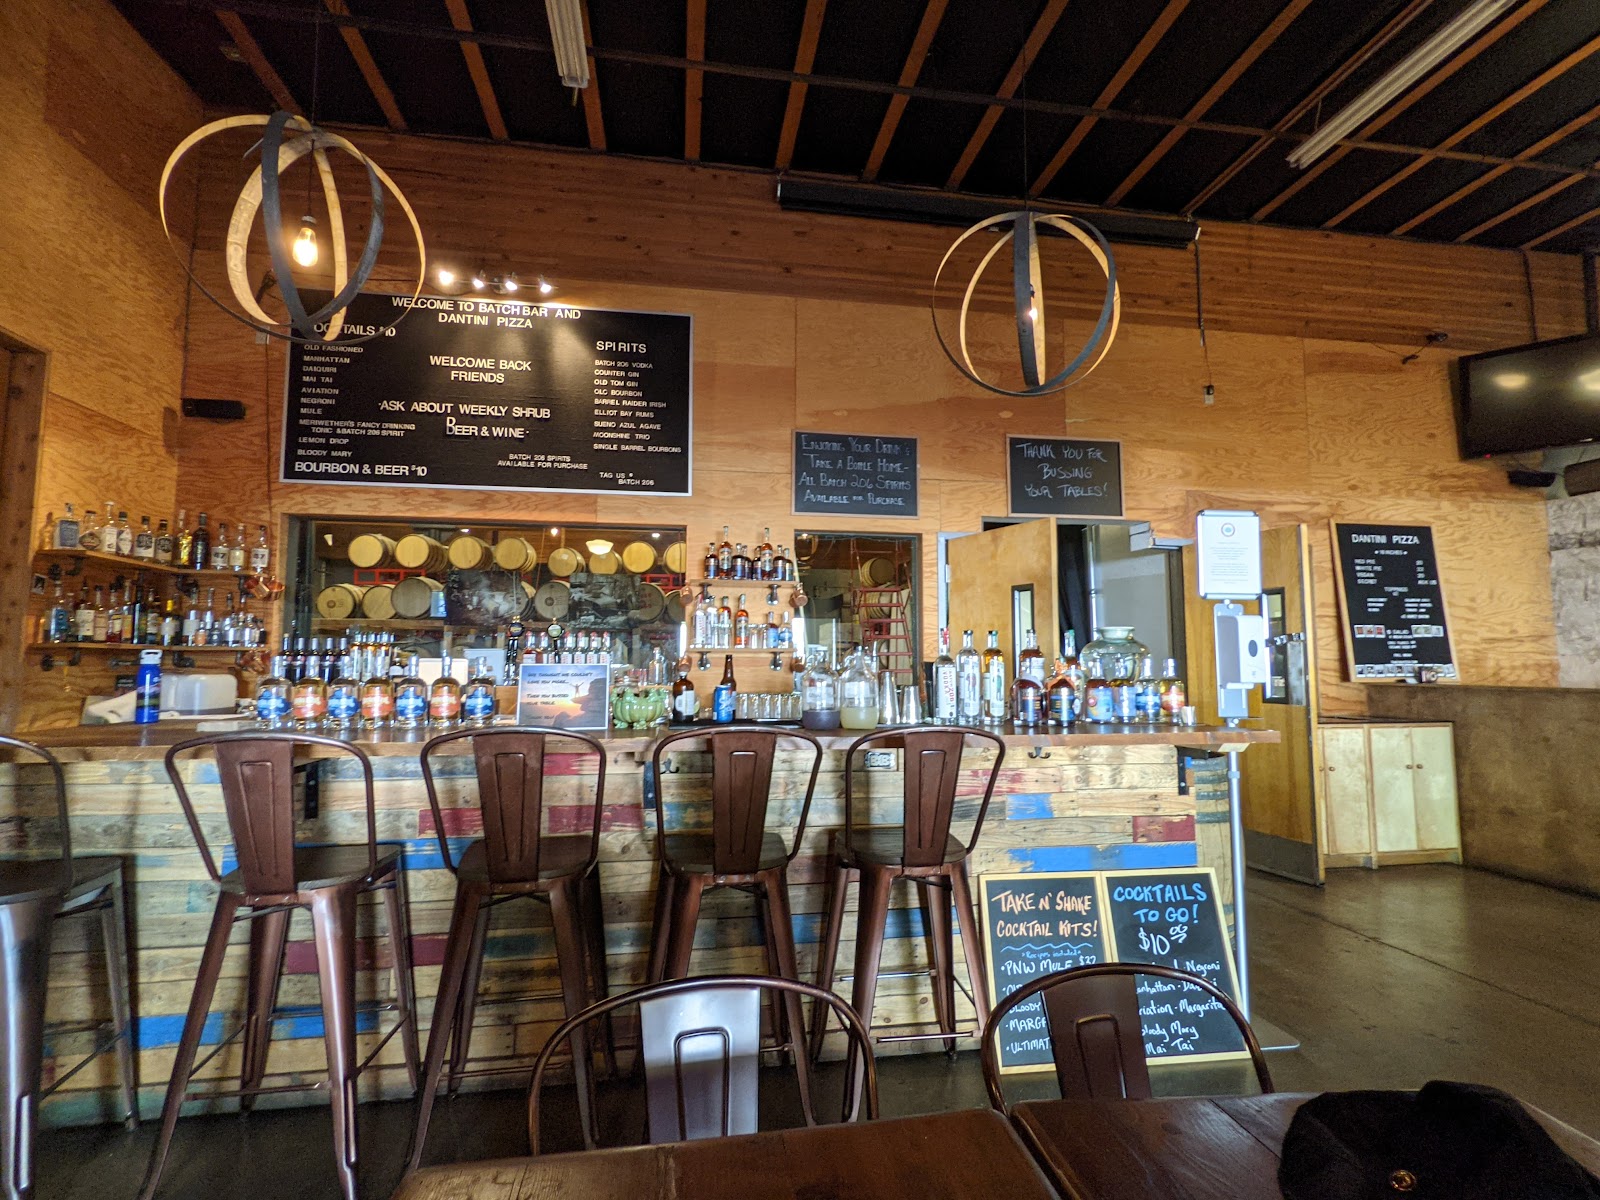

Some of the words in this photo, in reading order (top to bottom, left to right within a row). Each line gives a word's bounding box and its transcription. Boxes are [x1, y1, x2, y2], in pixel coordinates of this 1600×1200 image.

[392, 297, 454, 310] WELCOME
[458, 302, 475, 312] TO
[478, 303, 520, 315] BATCH
[522, 304, 548, 317] BAR
[555, 309, 581, 319] AND
[438, 312, 489, 326] DANTINI
[496, 316, 533, 329] PIZZA
[313, 322, 375, 336] OCTAILS
[322, 345, 364, 353] FASHIONED
[596, 341, 647, 353] SPIRITS
[304, 356, 350, 364] MANHATTAN
[430, 356, 495, 369] WELCOME
[499, 360, 532, 371] BACK
[451, 371, 505, 384] FRIENDS
[594, 369, 625, 377] COUNTER
[301, 387, 339, 395] AVIATION
[410, 402, 454, 414] ABOUT
[459, 404, 508, 416] WEEKLY
[512, 406, 551, 419] SHRUB
[650, 401, 666, 409] IRISH
[446, 417, 478, 436] BEER
[480, 427, 489, 436] &
[492, 427, 525, 438] WINE
[593, 432, 630, 440] MOONSHINE
[297, 449, 327, 457] BLOODY
[593, 443, 618, 451] SINGLE
[1016, 443, 1056, 459] THANK
[1062, 446, 1082, 459] YOU
[1087, 448, 1108, 462] FOR
[295, 462, 359, 474] BOURBON
[362, 465, 371, 475] &
[375, 465, 409, 476] BEER
[411, 465, 428, 477] $10
[553, 462, 588, 470] PURCHASE
[837, 460, 843, 469] A
[1037, 463, 1093, 480] BUSSING
[851, 475, 873, 489] 206
[804, 489, 850, 504] AVAILABLE
[868, 493, 905, 506] PURCHASE
[1025, 483, 1053, 499] YOUR
[1057, 482, 1108, 498] TABLES!
[1352, 534, 1387, 544] DANTINI
[1392, 535, 1420, 544] PIZZA
[1113, 882, 1208, 904] COCKTAILS
[991, 890, 1036, 915] TAKE
[1055, 891, 1093, 916] SHAKE
[1133, 908, 1160, 924] TO
[1165, 903, 1199, 924] GO!
[996, 920, 1053, 937] COCKTAIL
[1059, 919, 1098, 937] KITS!
[1005, 960, 1036, 976] PNW
[1185, 959, 1221, 977] Negroni
[1136, 980, 1176, 995] anhattan
[1170, 1021, 1199, 1039] Mary
[1010, 1037, 1050, 1054] ULTIMAT
[1146, 1043, 1167, 1055] Mai
[1171, 1038, 1195, 1051] Tai
